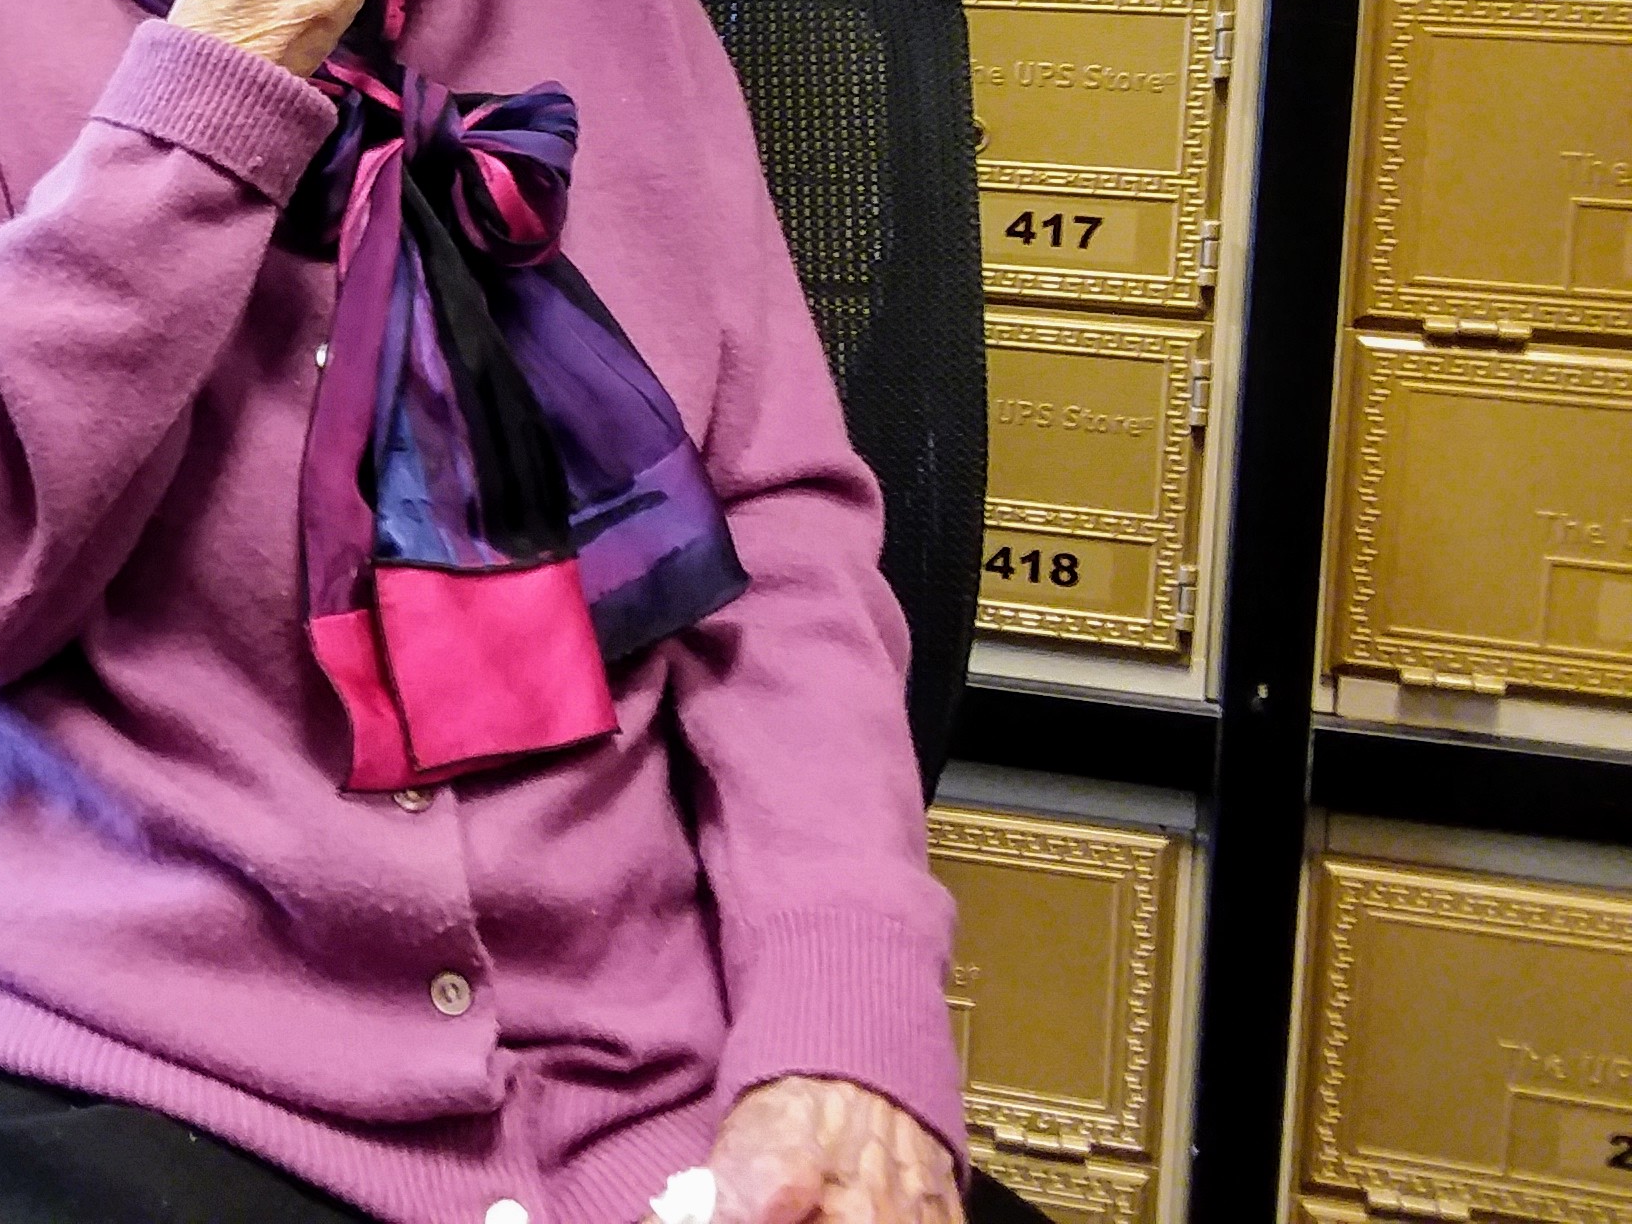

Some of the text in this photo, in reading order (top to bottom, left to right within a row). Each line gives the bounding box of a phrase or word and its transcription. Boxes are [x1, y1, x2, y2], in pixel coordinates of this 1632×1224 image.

[1016, 61, 1075, 89] UPS
[1006, 212, 1102, 249] 417
[985, 546, 1079, 587] 418
